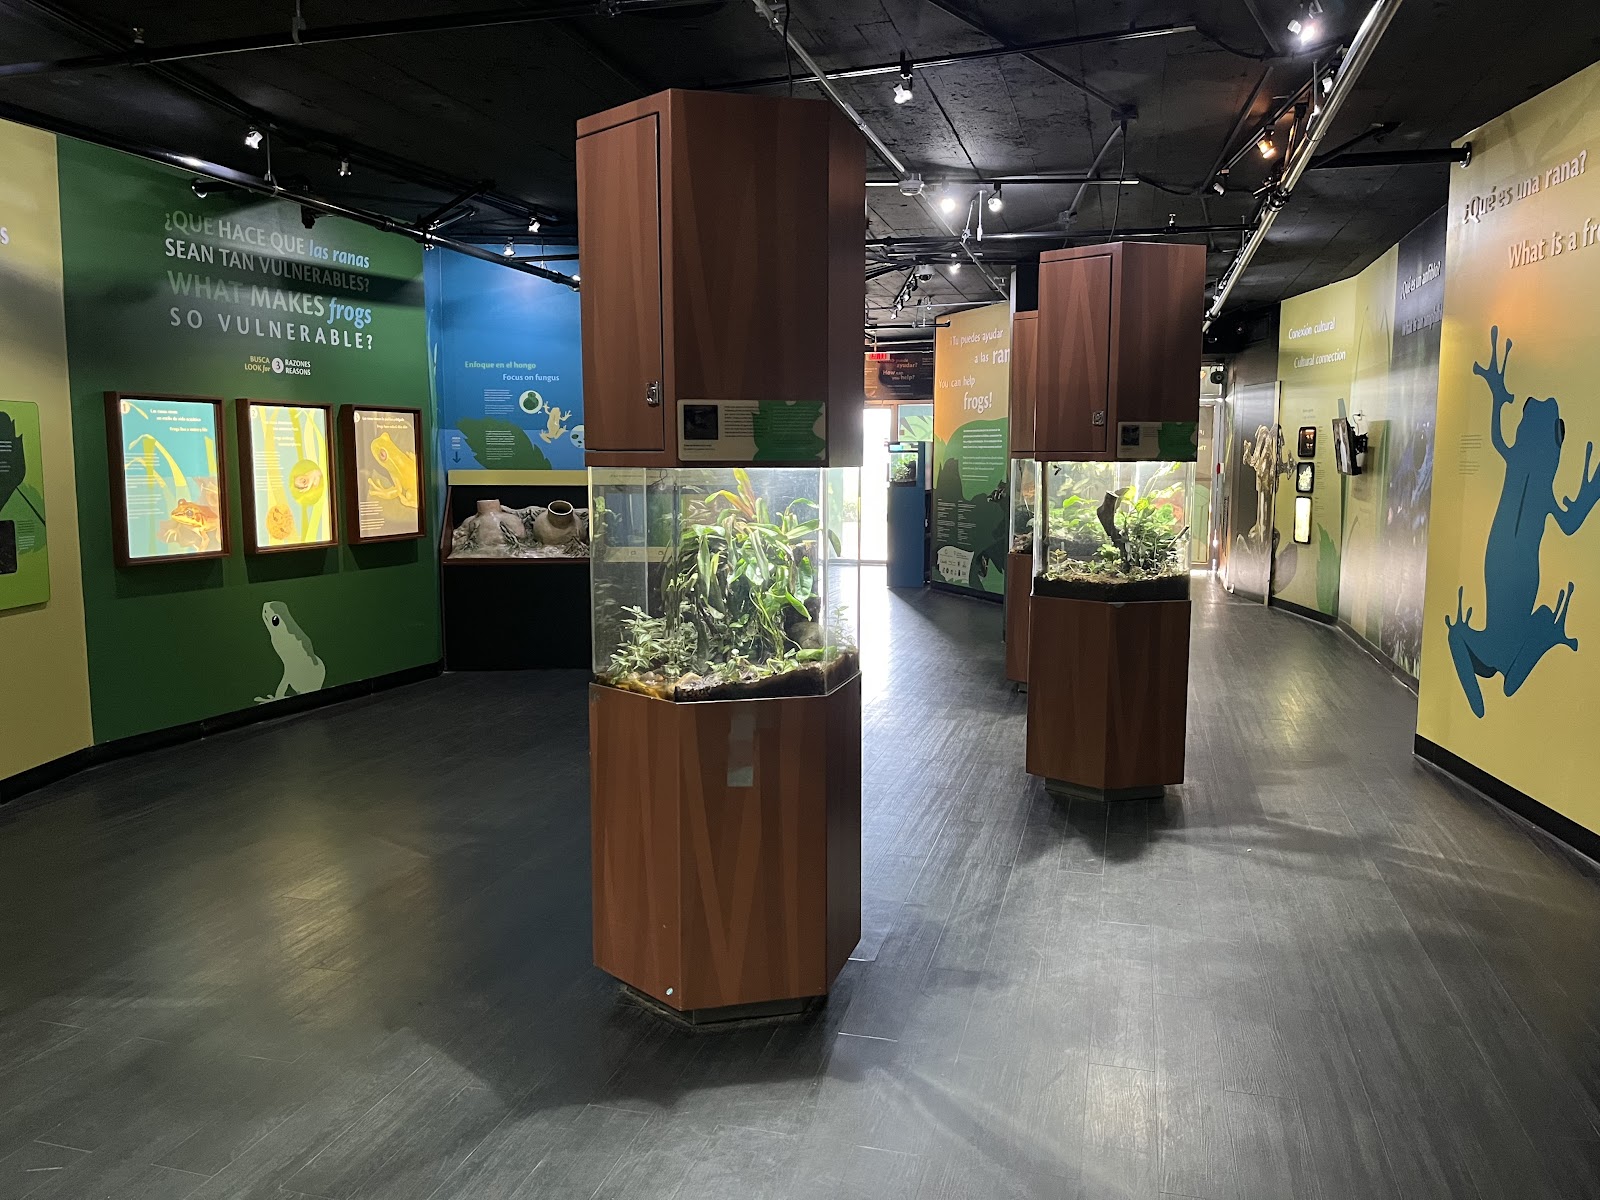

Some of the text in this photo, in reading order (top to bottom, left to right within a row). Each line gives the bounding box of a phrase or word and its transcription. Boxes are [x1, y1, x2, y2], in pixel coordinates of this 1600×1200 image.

[1462, 149, 1588, 224] ¿Qué es una rana?
[219, 219, 266, 247] HACE
[270, 231, 305, 255] QUE
[309, 239, 329, 260] las
[333, 249, 370, 269] ranas
[1508, 238, 1547, 269] What
[1551, 231, 1563, 257] is
[1567, 231, 1578, 251] a
[165, 238, 370, 293] SEAN TAN VULNERABLES?
[167, 270, 372, 329] WHAT MAKES frogs
[170, 306, 373, 350] SO VULNERABLE?
[1314, 316, 1336, 334] cultural
[960, 332, 980, 348] puedes
[982, 327, 1004, 343] ayudar
[249, 355, 270, 364] BUSCA
[284, 359, 311, 368] RAZONES
[464, 360, 495, 370] Enfoque
[506, 361, 513, 369] el
[513, 361, 537, 371] hongo
[980, 352, 989, 363] las
[1315, 348, 1346, 365] connection
[244, 363, 311, 376] LOOK for REASONS
[502, 373, 524, 381] Focus
[535, 373, 560, 382] fungus
[938, 375, 976, 389] You can help
[963, 391, 993, 414] frogs!
